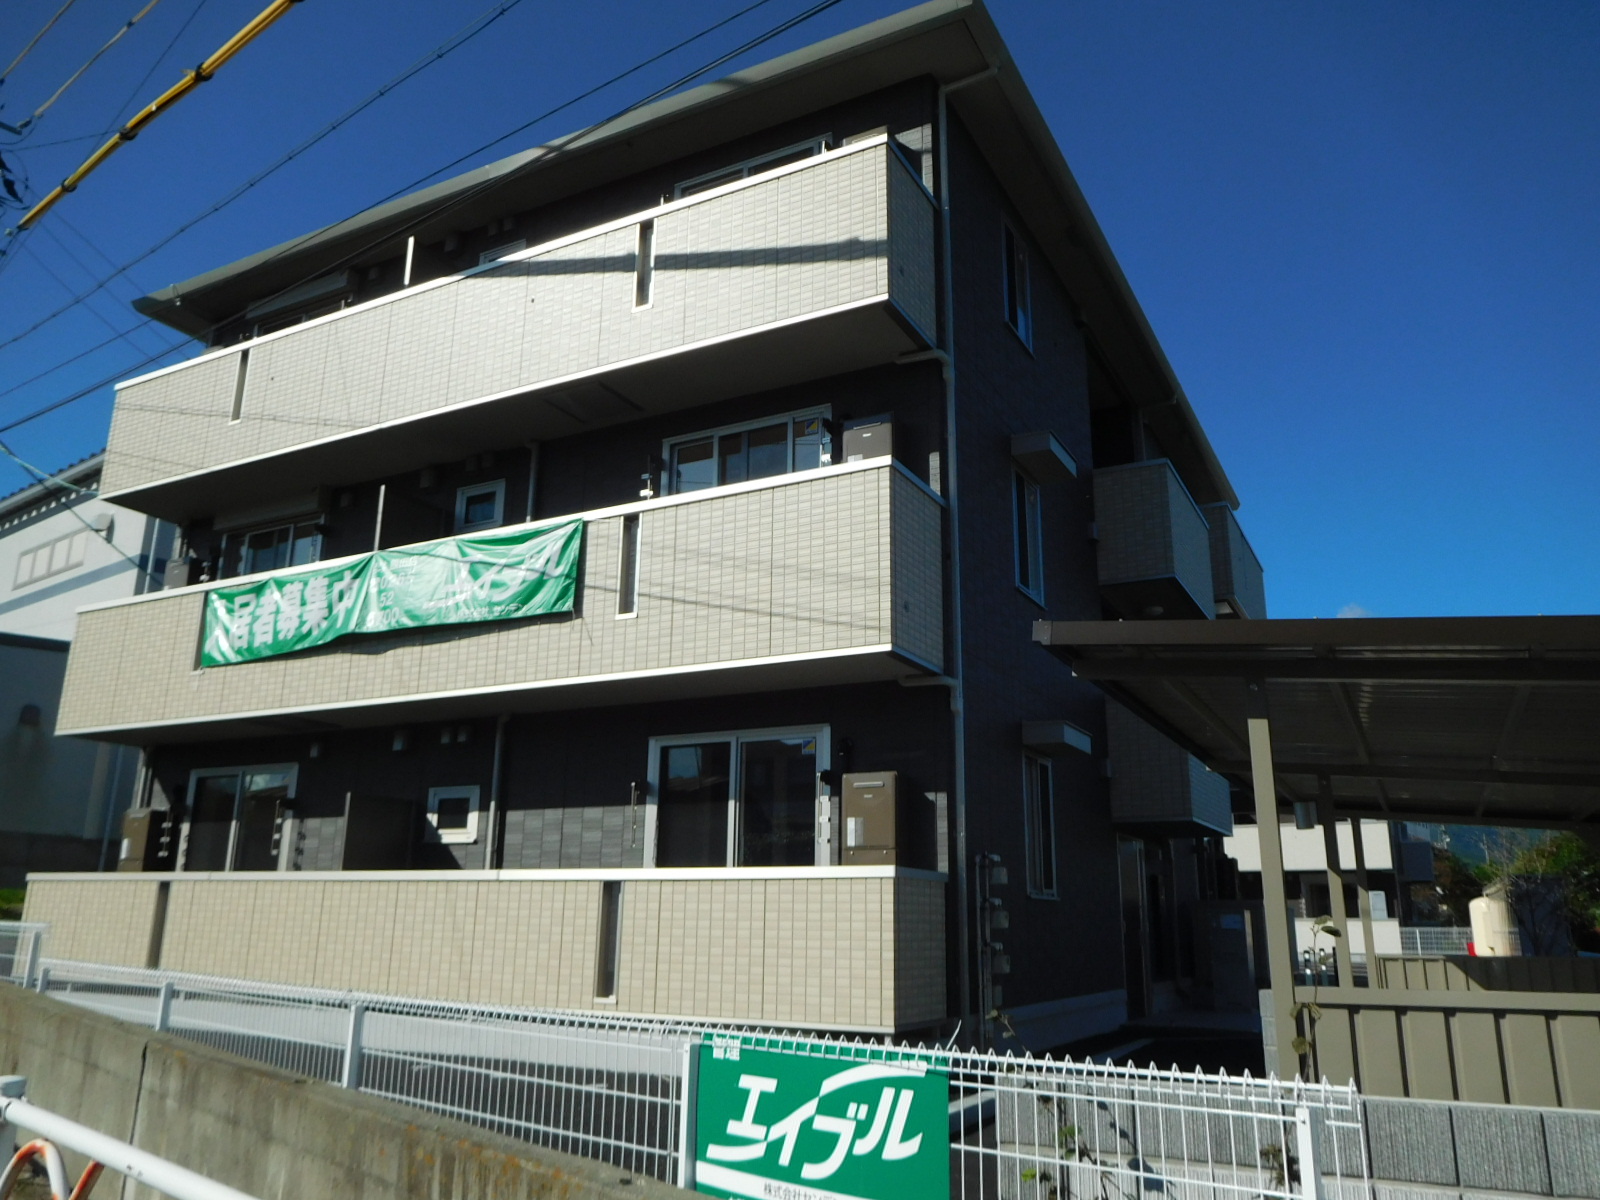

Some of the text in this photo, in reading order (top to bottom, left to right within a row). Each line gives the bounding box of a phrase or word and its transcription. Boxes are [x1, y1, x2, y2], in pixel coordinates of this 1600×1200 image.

[204, 570, 361, 662] 入居者募集中
[708, 1062, 925, 1180] エイブル
